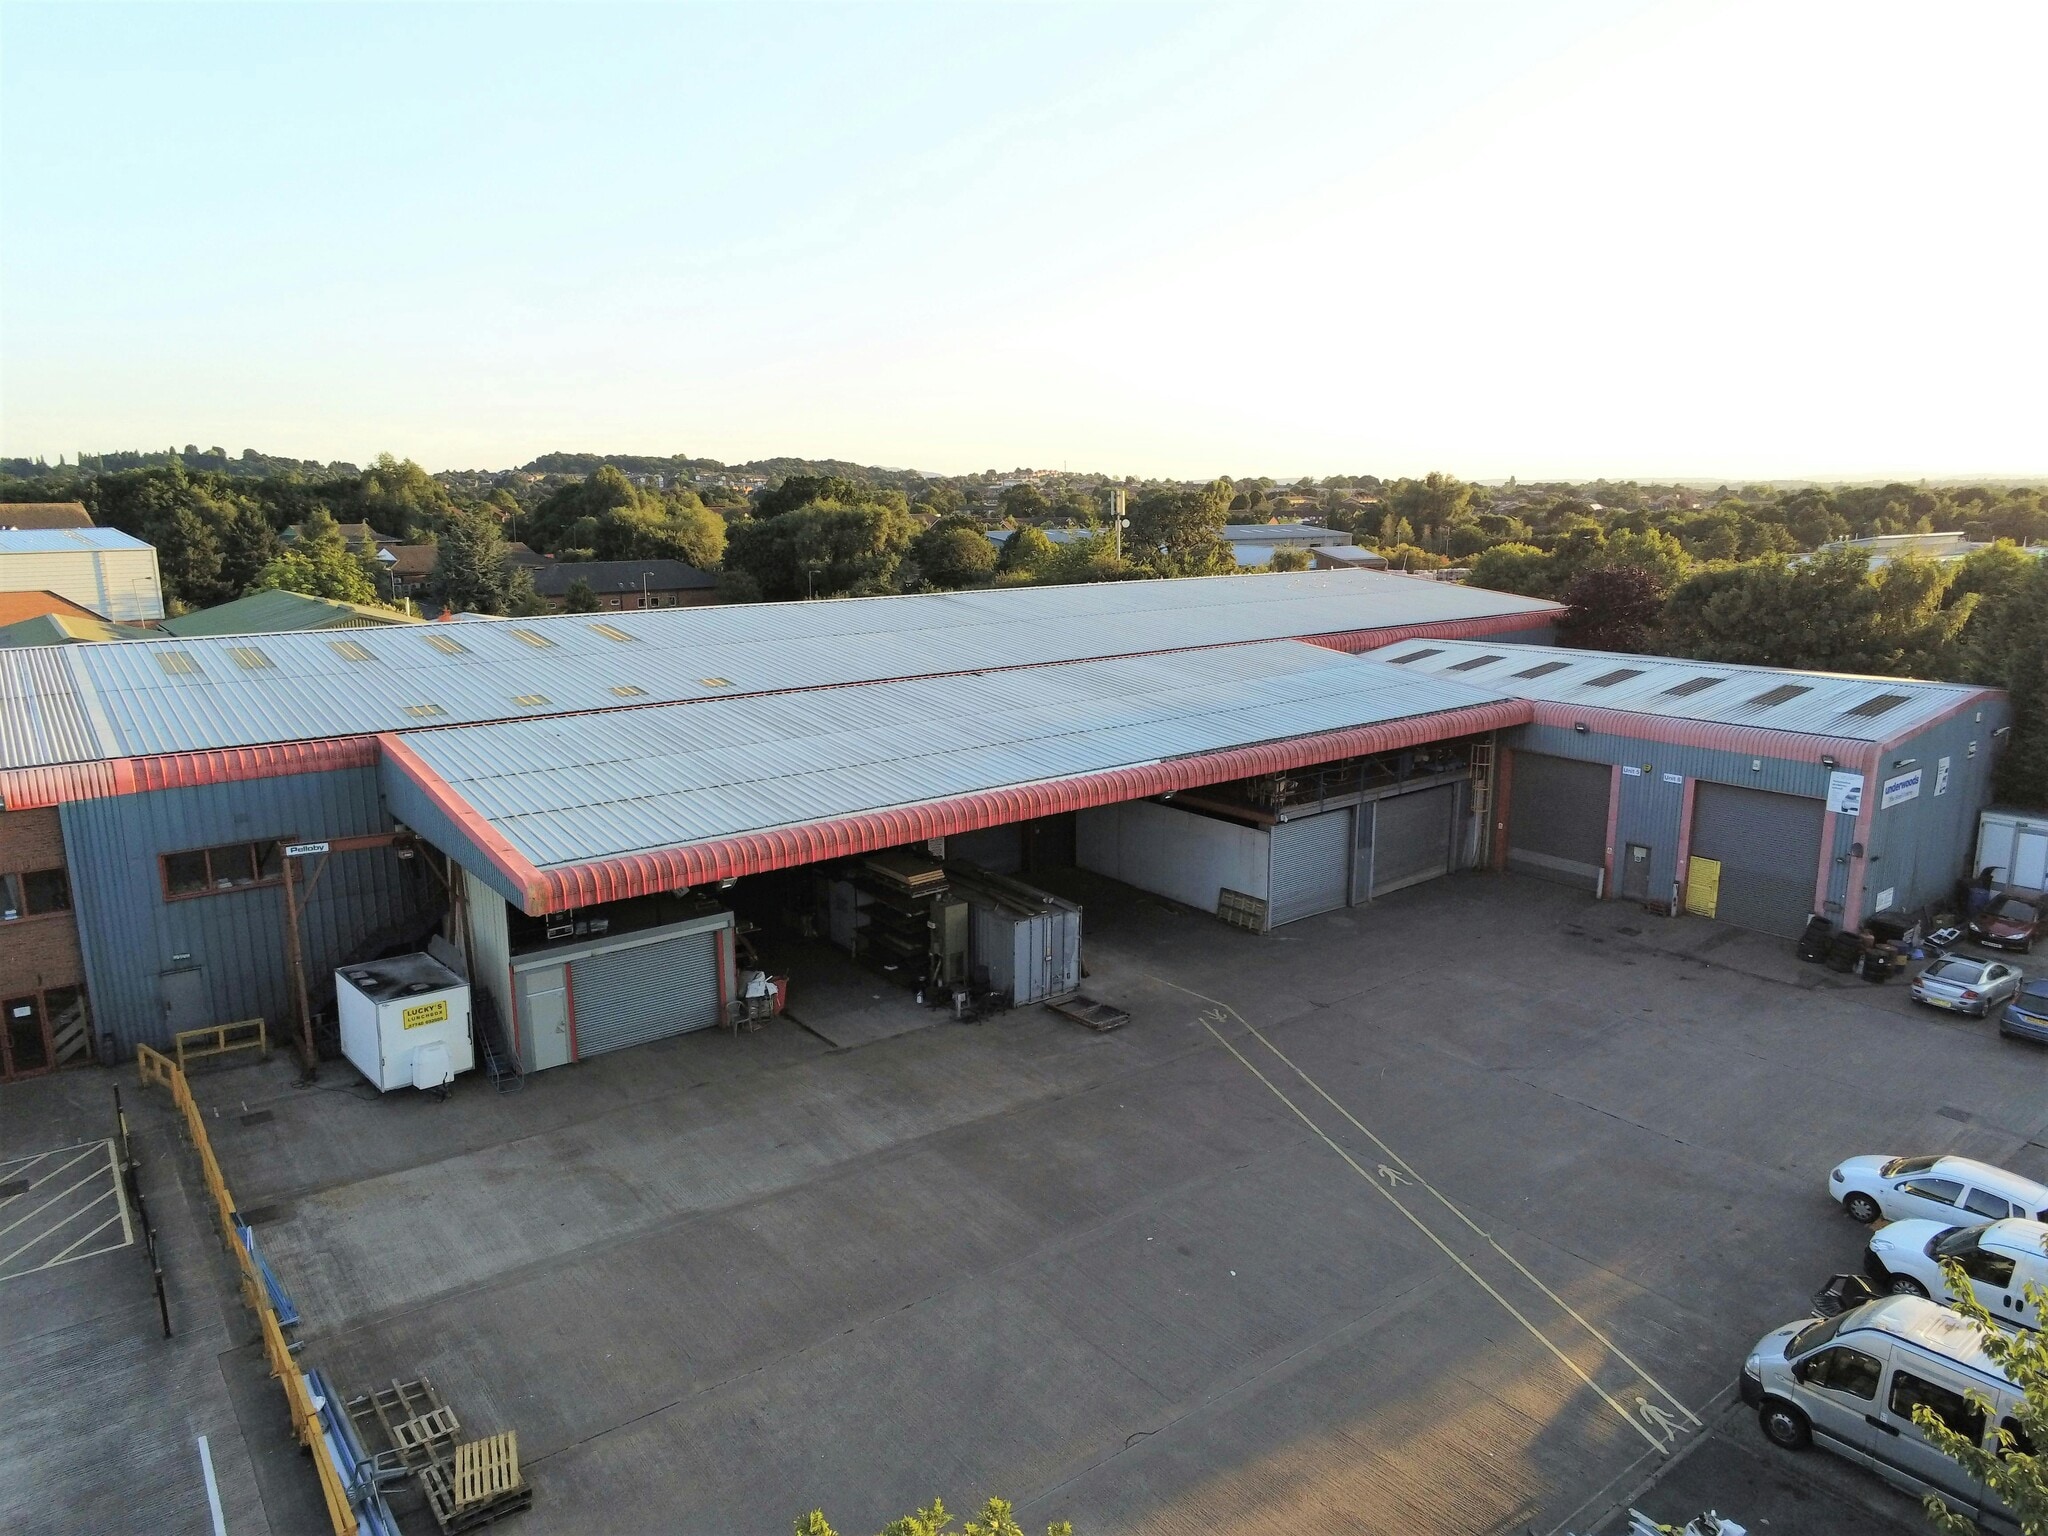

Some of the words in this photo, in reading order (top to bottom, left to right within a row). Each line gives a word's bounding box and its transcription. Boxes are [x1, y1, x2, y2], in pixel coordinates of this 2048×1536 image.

[1885, 774, 1920, 795] underwoods
[290, 845, 325, 853] Pelloby
[407, 1003, 443, 1017] LUCKY'S
[407, 1010, 443, 1022] LUNCHBOX
